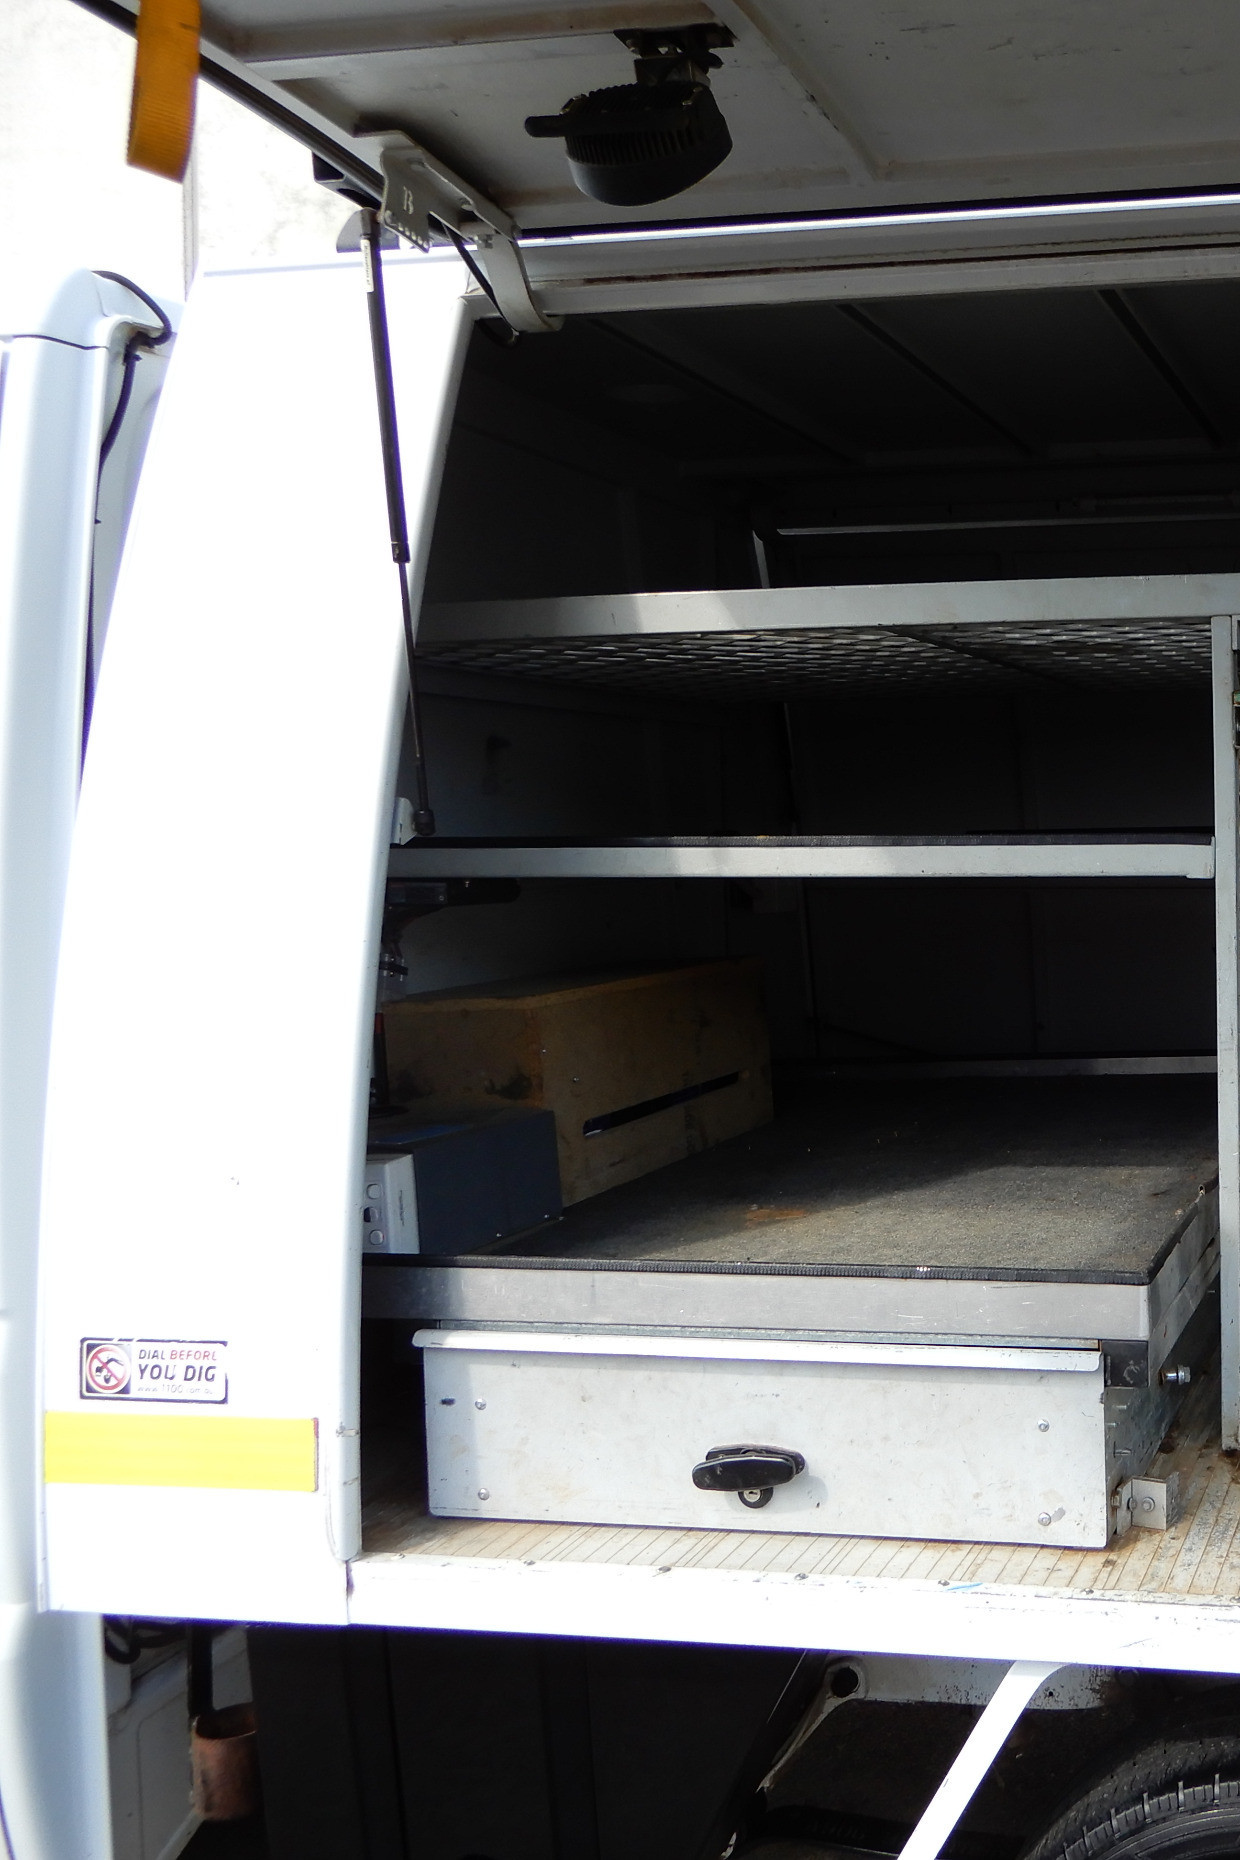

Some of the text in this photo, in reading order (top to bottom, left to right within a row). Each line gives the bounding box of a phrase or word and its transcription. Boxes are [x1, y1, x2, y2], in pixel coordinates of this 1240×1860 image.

[138, 1349, 217, 1361] DIAL BEFORE
[138, 1363, 217, 1382] YOU DIG
